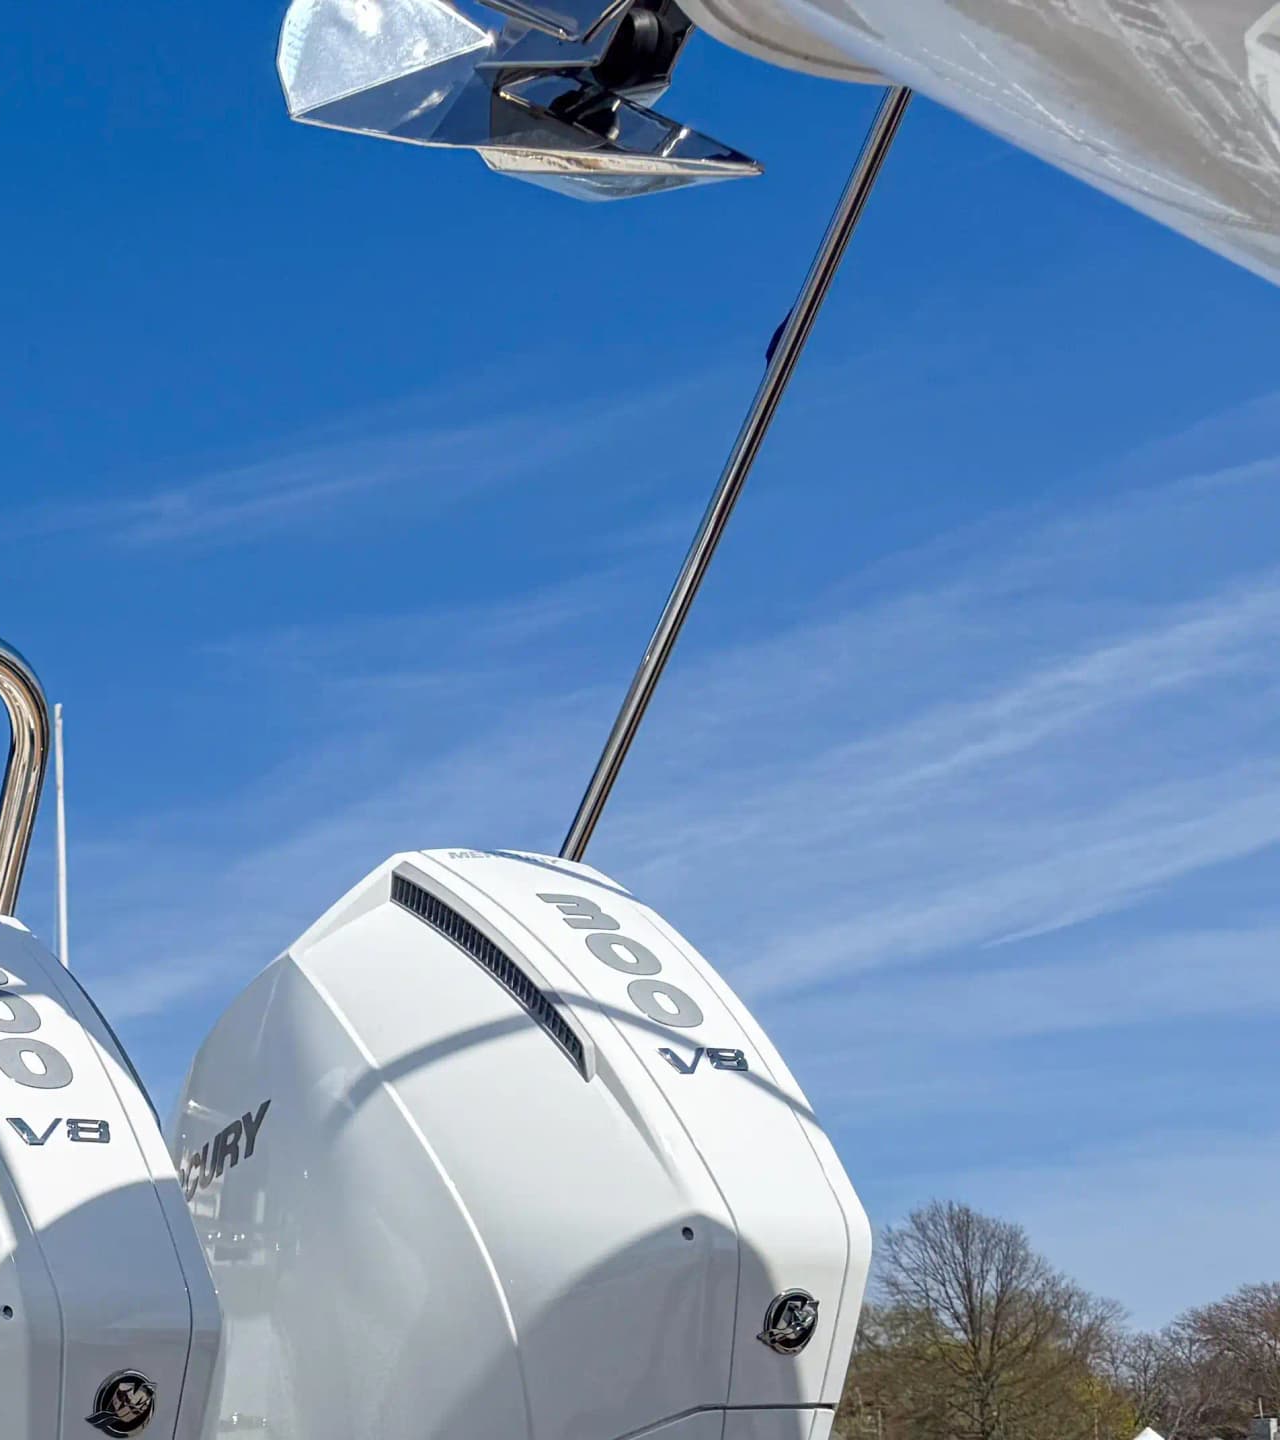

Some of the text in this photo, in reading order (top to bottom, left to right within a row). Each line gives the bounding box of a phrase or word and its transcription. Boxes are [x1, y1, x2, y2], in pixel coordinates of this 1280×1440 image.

[536, 892, 704, 1028] 300
[657, 1046, 749, 1075] V8
[5, 1117, 111, 1147] V8
